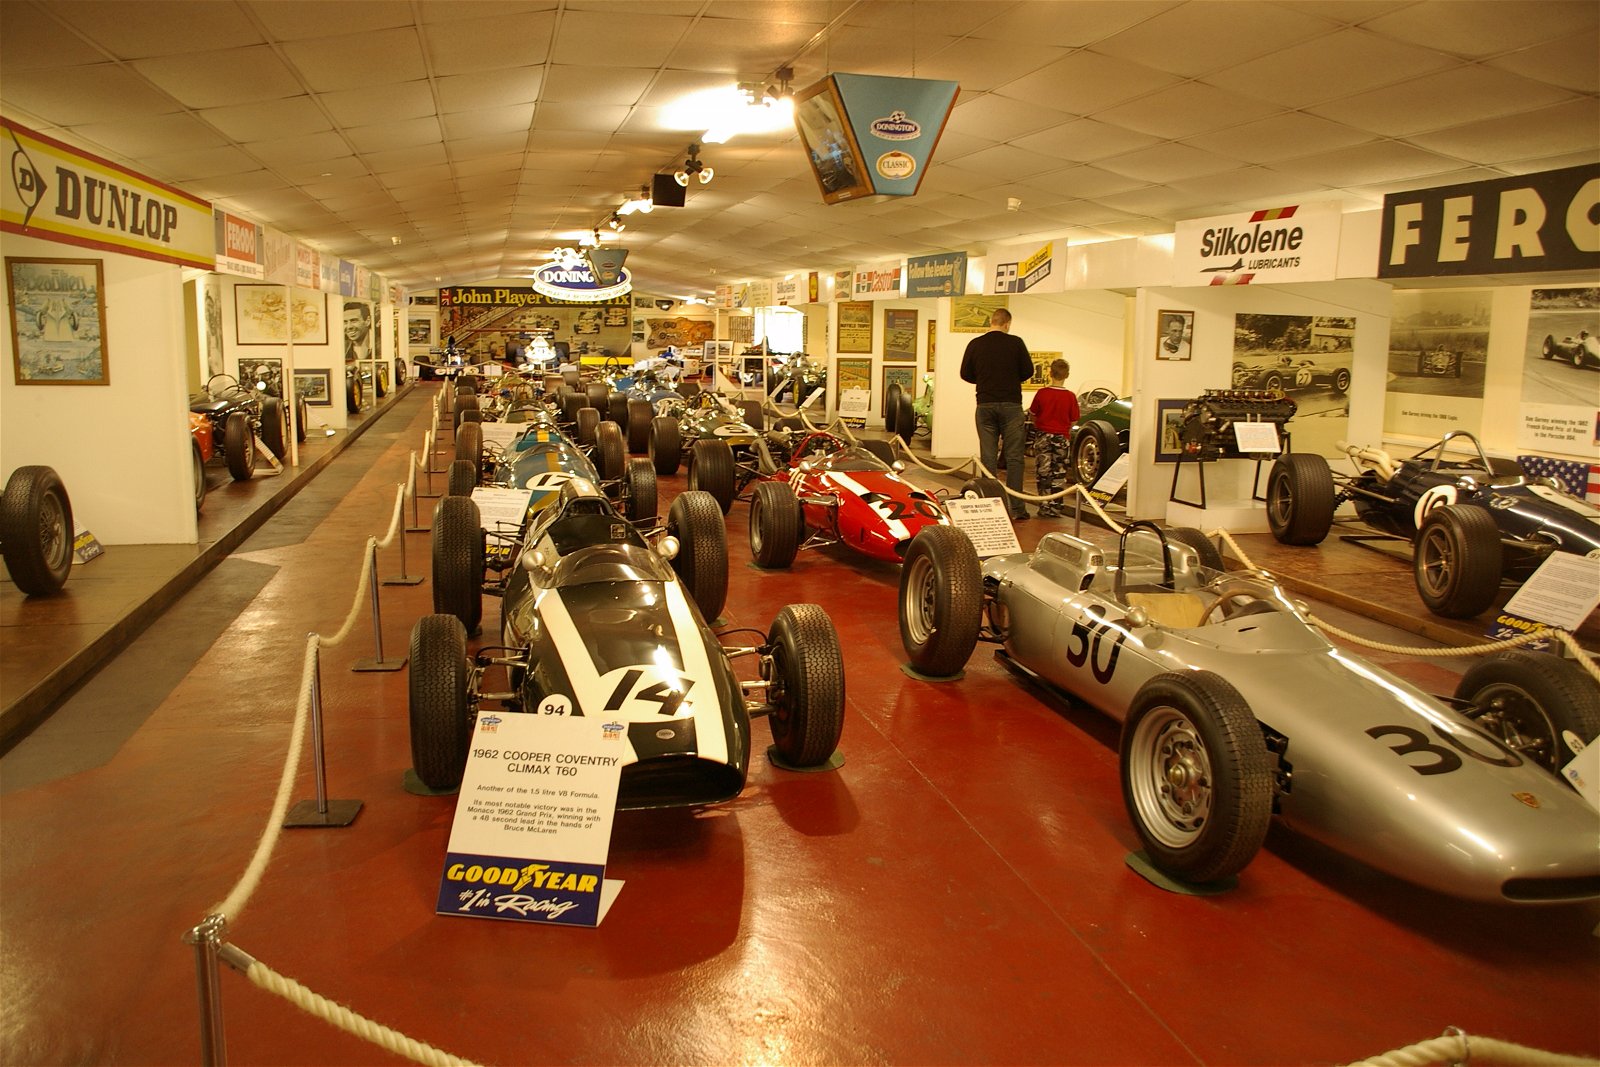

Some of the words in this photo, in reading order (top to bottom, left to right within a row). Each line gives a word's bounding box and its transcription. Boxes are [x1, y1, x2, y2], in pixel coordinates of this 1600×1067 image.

[877, 123, 914, 132] DONINGTON
[56, 166, 177, 243] DUNLOP
[228, 221, 254, 255] FERODO
[1200, 224, 1303, 258] Silkolene
[909, 262, 924, 278] Follow
[924, 261, 934, 277] the
[934, 260, 953, 276] leader
[1248, 257, 1300, 270] LUBRICANTS
[872, 270, 894, 292] Castrol
[453, 289, 492, 304] John
[494, 289, 544, 307] Player
[1299, 373, 1309, 384] 27
[879, 501, 943, 520] 20
[603, 669, 696, 716] 14
[544, 704, 565, 716] 94
[1364, 722, 1524, 775] 30
[473, 749, 499, 759] 1962
[503, 750, 551, 762] COOPER
[556, 754, 619, 767] COVENTRY
[507, 763, 550, 775] CLIMAX
[556, 766, 578, 776] T60
[570, 791, 600, 799] Formula.
[467, 806, 495, 814] Monaco
[557, 813, 583, 821] winning
[505, 801, 531, 809] notable
[534, 803, 558, 812] victory
[492, 816, 517, 824] second
[504, 824, 524, 832] Bruce
[527, 826, 557, 834] McLaren
[447, 863, 598, 892] GOODYEAR
[494, 894, 579, 919] Racing
